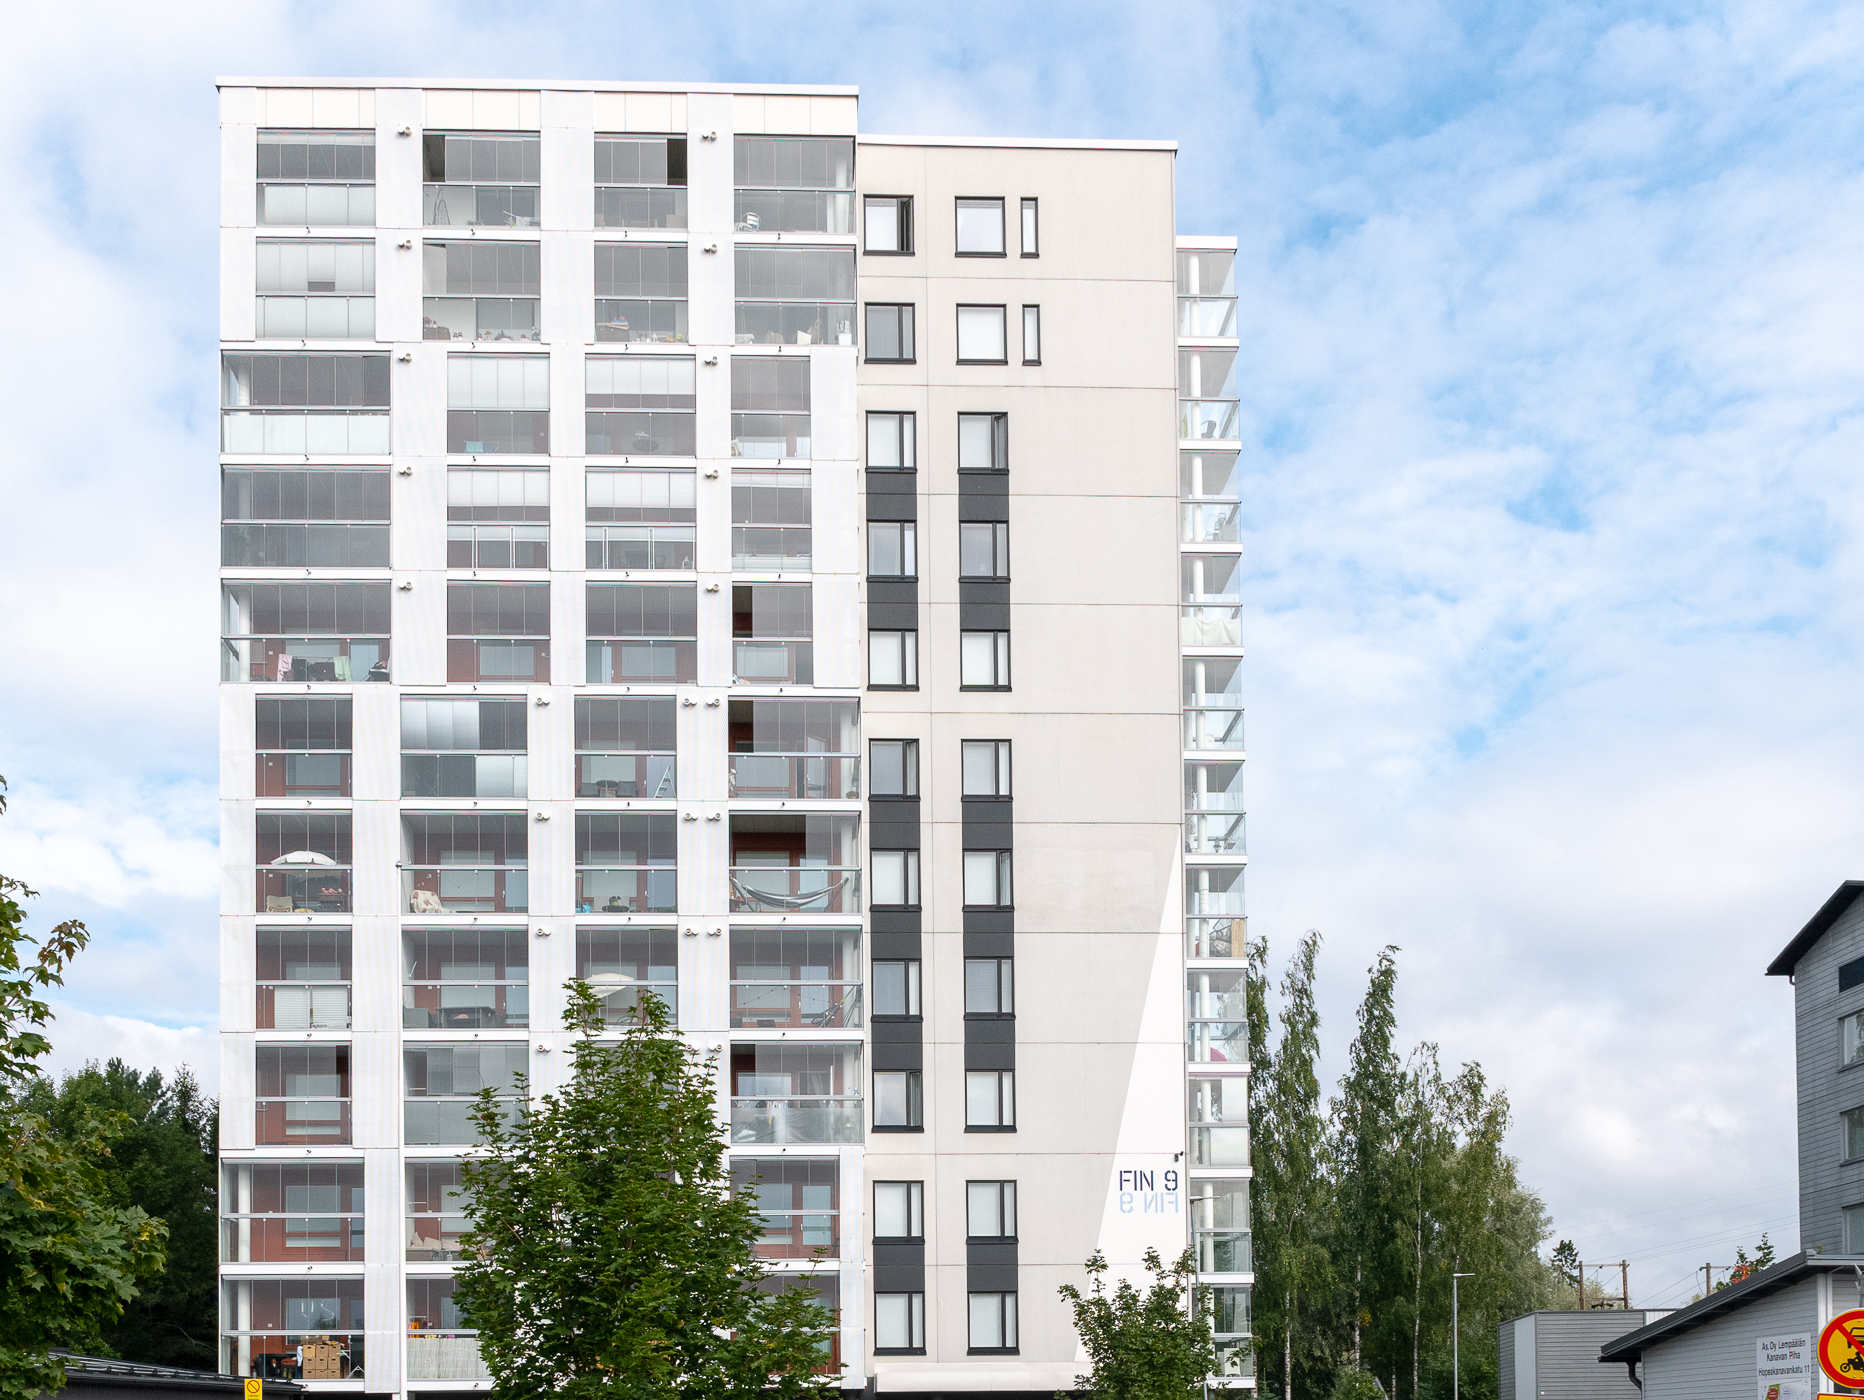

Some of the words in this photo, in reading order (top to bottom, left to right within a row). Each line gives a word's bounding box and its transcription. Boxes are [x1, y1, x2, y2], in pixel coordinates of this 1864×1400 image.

[1119, 1170, 1154, 1191] FIN
[1164, 1170, 1178, 1191] 9
[1769, 1341, 1777, 1352] Oy
[1778, 1338, 1806, 1350] Lempäälän
[1766, 1353, 1788, 1361] Kanavan
[1789, 1351, 1801, 1360] Piha
[1804, 1364, 1810, 1373] 11
